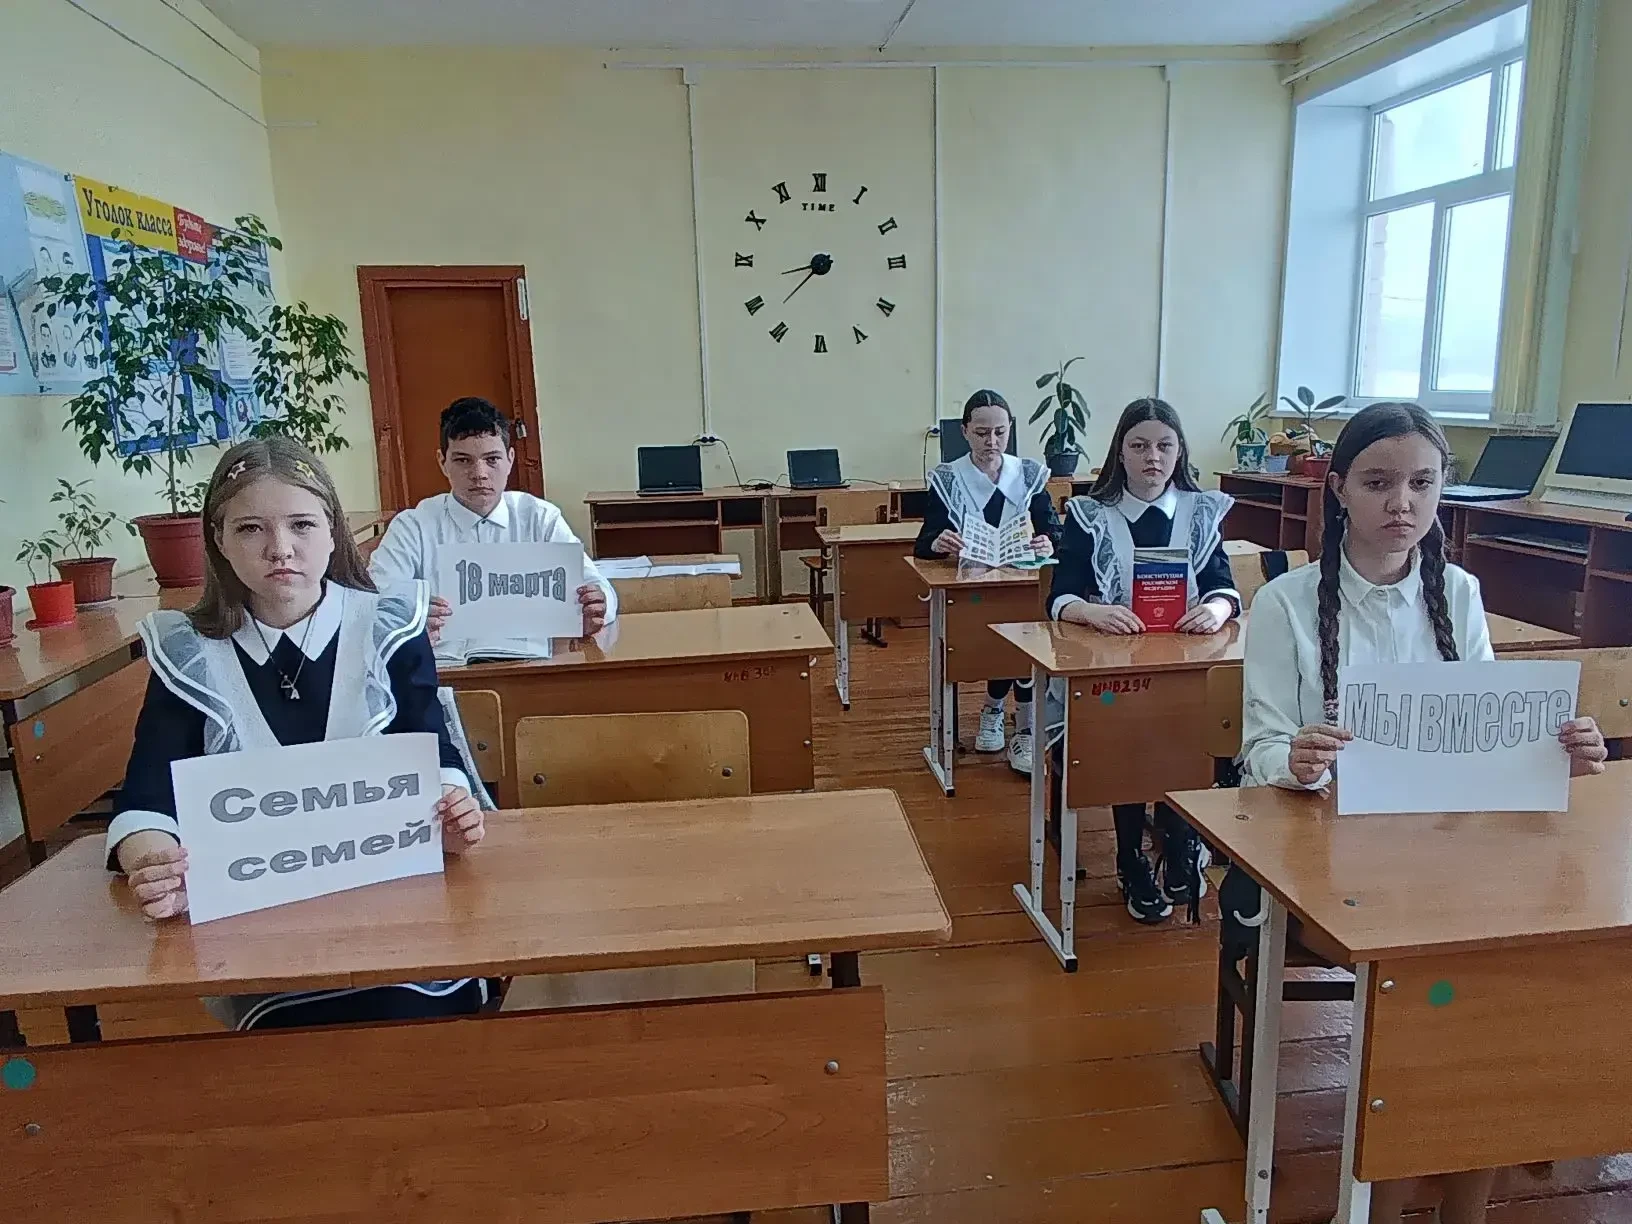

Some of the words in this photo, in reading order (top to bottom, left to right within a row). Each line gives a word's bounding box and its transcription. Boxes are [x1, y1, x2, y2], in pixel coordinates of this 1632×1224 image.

[771, 181, 791, 204] XI
[812, 173, 827, 192] XII
[852, 186, 868, 205] I
[82, 187, 133, 228] Уголок
[136, 210, 174, 237] класса
[802, 202, 835, 212] TIME
[455, 559, 483, 605] 18
[488, 566, 567, 602] марта
[1344, 683, 1412, 750] Мы
[1417, 689, 1572, 753] вместе
[209, 773, 420, 823] Семья
[228, 819, 432, 881] семей
